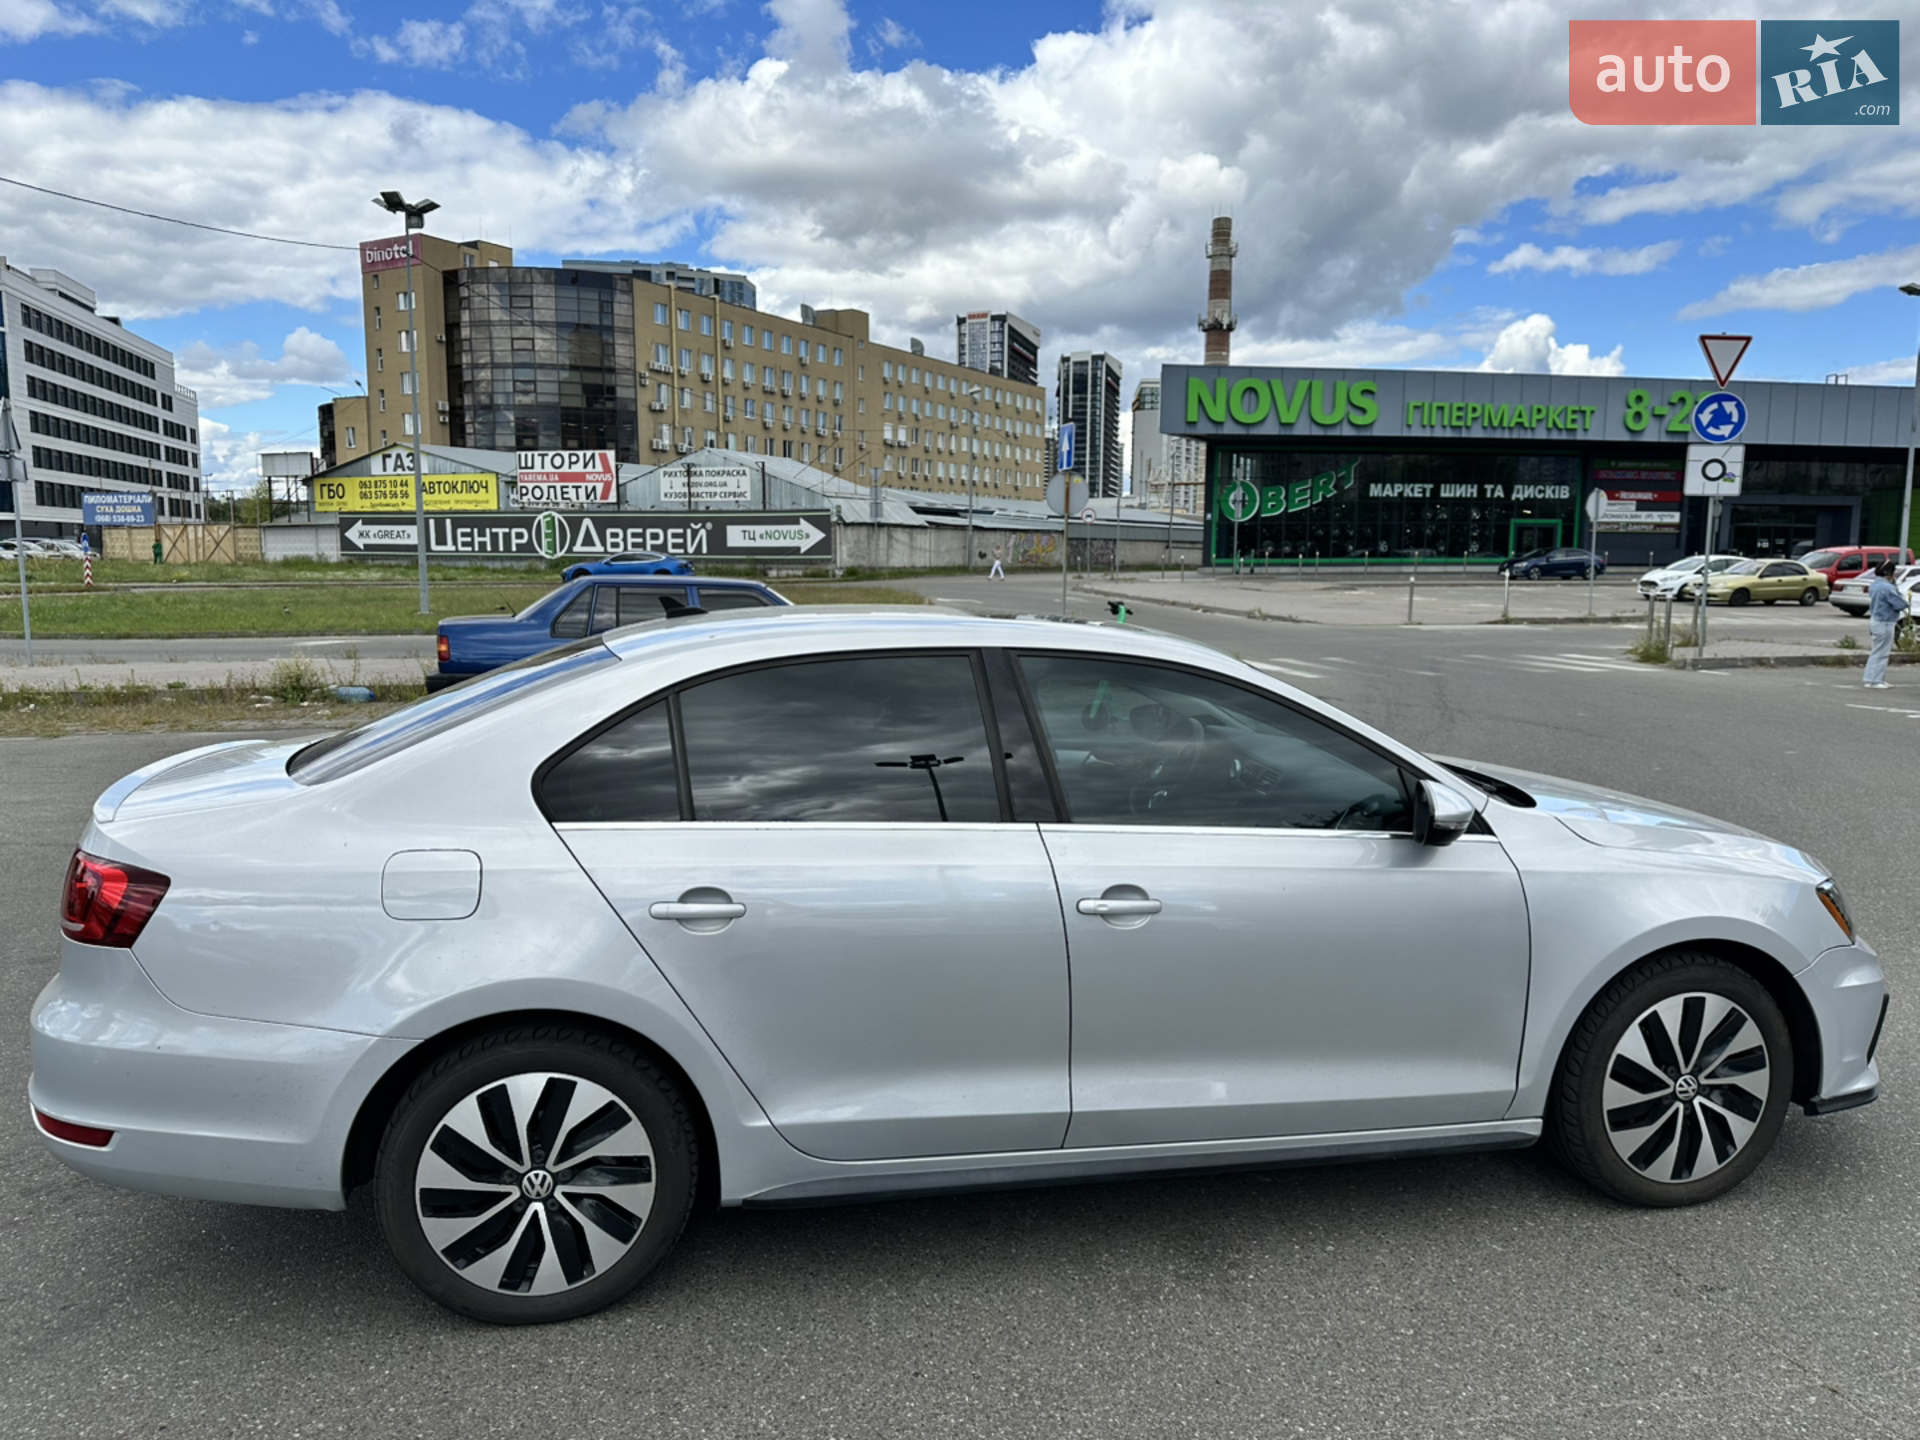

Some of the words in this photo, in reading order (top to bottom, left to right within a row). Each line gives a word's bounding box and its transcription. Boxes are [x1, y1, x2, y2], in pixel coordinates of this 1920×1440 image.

[365, 240, 414, 263] binotel
[1185, 376, 1379, 426] NOVUS
[1405, 400, 1597, 430] ГІПЕРМАРКЕТ
[1624, 388, 1713, 433] 8-2
[381, 453, 415, 473] ГАЗ
[518, 452, 596, 470] ШТОРИ
[585, 473, 612, 481] NOVUS
[705, 469, 747, 477] ПОКРАСКА
[319, 483, 345, 500] ГБО
[359, 481, 373, 490] 063
[374, 480, 387, 489] 875
[389, 479, 398, 489] 10
[399, 479, 409, 488] 44
[421, 479, 489, 495] АВТОКЛЮЧ
[1369, 483, 1434, 497] МАРКЕТ
[1440, 484, 1478, 497] ШИН
[1484, 484, 1505, 498] ТА
[1511, 485, 1570, 500] ДИСКІВ
[84, 494, 153, 504] ПИЛОМАТЕРІАЛИ
[359, 490, 373, 500] 063
[374, 490, 388, 499] 576
[389, 490, 398, 499] 56
[400, 489, 409, 499] 56
[520, 485, 597, 501] РОЛЕТИ
[663, 491, 688, 499] КУЗОВ
[689, 491, 717, 499] МАСТЕР
[719, 490, 748, 498] СЕРВИС
[357, 530, 371, 539] ЖК
[373, 530, 411, 540] «GREAT»
[428, 518, 529, 552] ЦЕНТР
[573, 517, 708, 554] ДВЕРЕЙ
[741, 530, 756, 541] ТЦ
[759, 530, 811, 541] «NOVUS»
